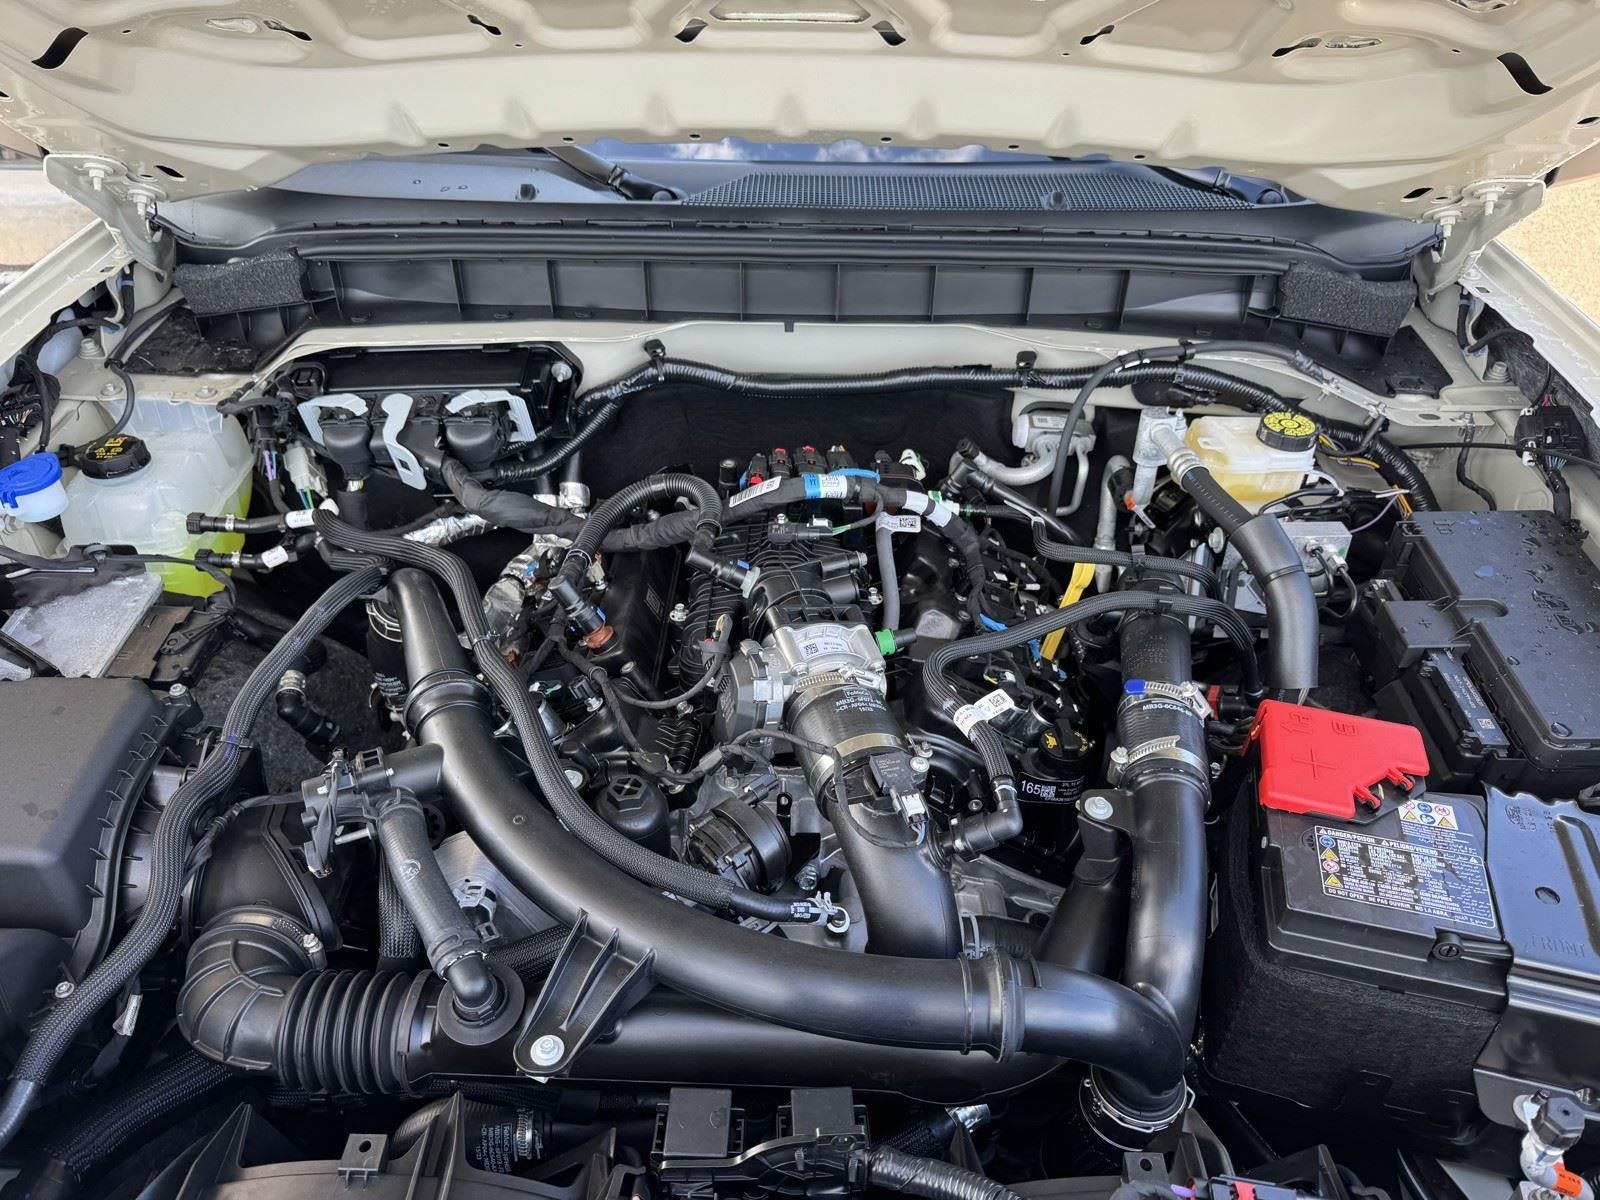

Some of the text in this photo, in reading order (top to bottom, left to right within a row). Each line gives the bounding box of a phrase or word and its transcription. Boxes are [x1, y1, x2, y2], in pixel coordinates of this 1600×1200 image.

[1021, 780, 1041, 795] 165
[1327, 830, 1376, 843] DANGER/POISON
[1337, 889, 1349, 897] NOT
